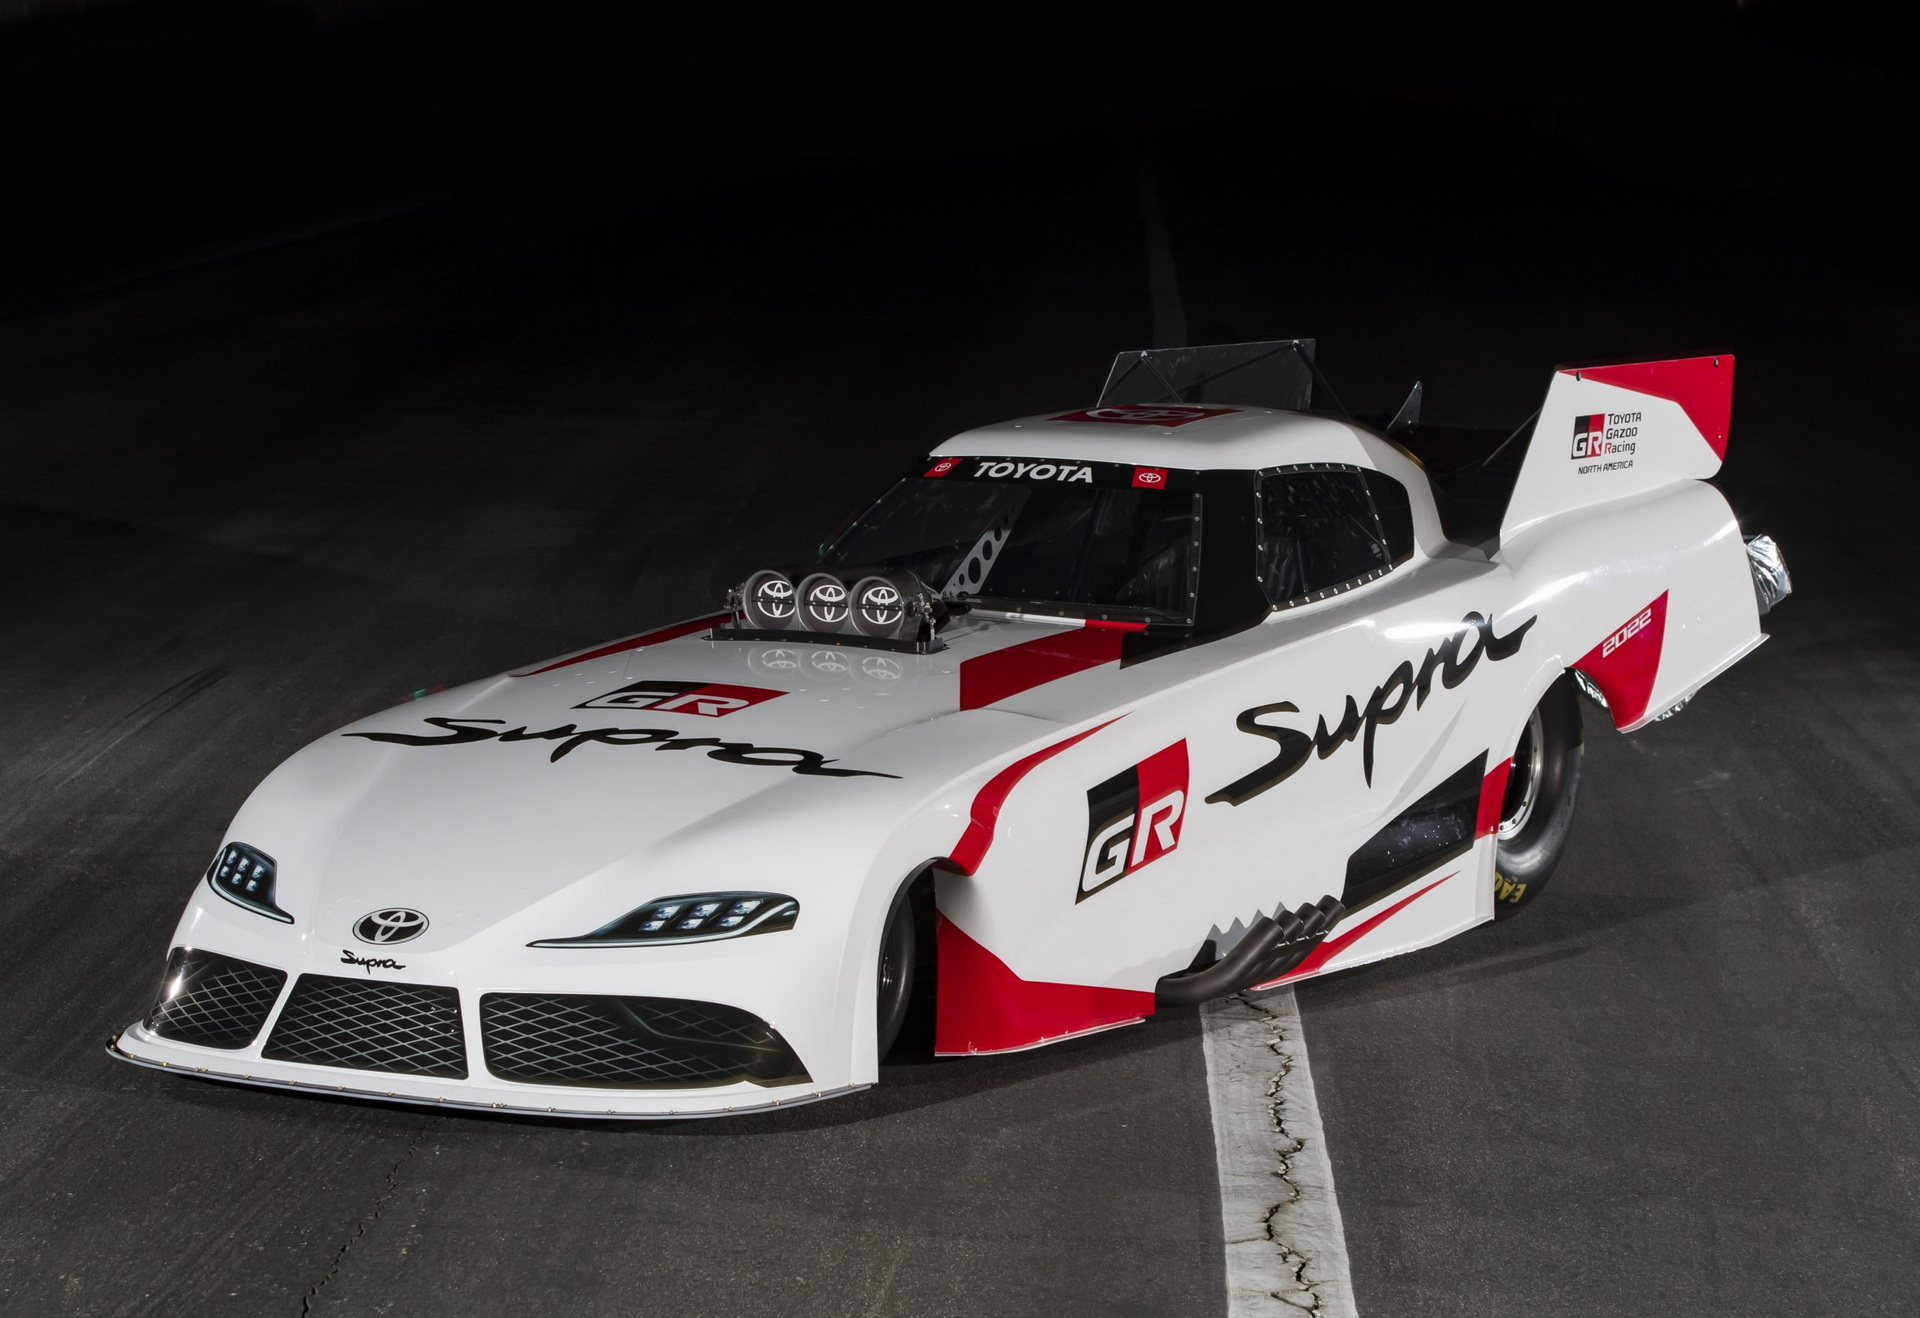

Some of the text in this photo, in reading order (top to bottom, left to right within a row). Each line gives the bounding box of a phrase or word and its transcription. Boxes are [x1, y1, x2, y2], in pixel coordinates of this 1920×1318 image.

[1608, 412, 1641, 425] TOYOTA
[1572, 431, 1603, 457] GR
[1606, 427, 1638, 440] GAZOO
[1605, 441, 1636, 455] Racing
[973, 462, 1093, 483] TOYOTA
[1578, 460, 1633, 475] NORTH AMERICA
[1602, 608, 1651, 658] 2022
[585, 691, 749, 716] GR
[1205, 611, 1537, 806] Supra
[341, 717, 903, 779] Supra
[1082, 790, 1184, 892] GR
[341, 949, 406, 975] Supra
